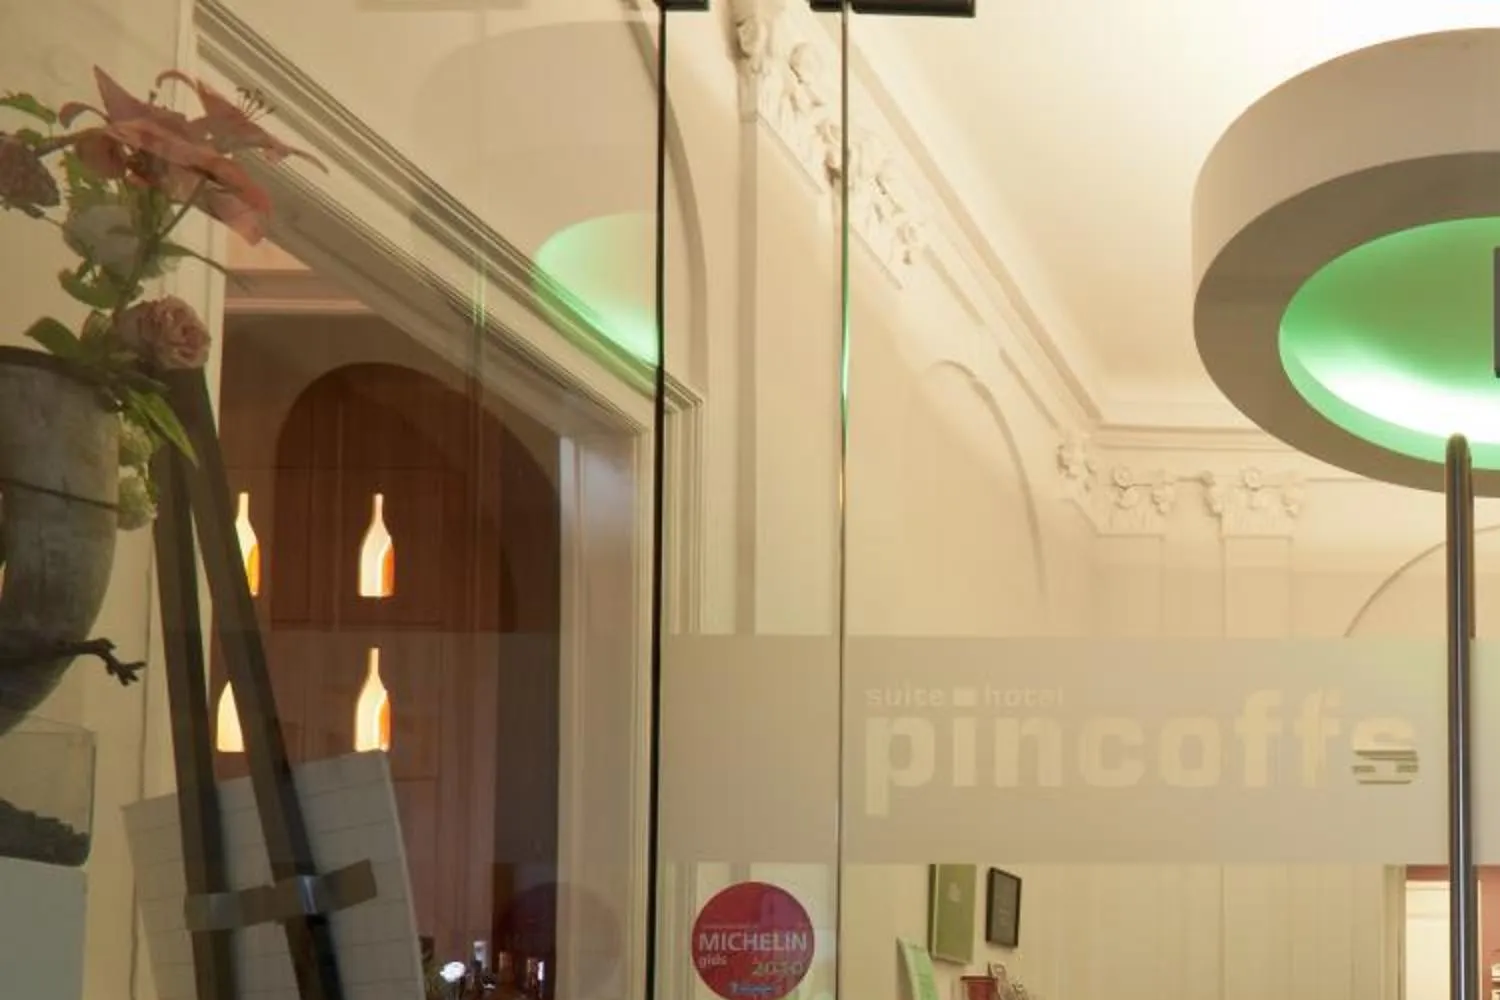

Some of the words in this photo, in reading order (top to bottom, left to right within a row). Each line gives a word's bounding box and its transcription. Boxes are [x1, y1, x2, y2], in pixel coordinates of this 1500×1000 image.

[864, 688, 945, 707] suite
[984, 683, 1064, 707] hotel
[864, 687, 1420, 816] pincoffs
[698, 931, 808, 952] MICHELIN
